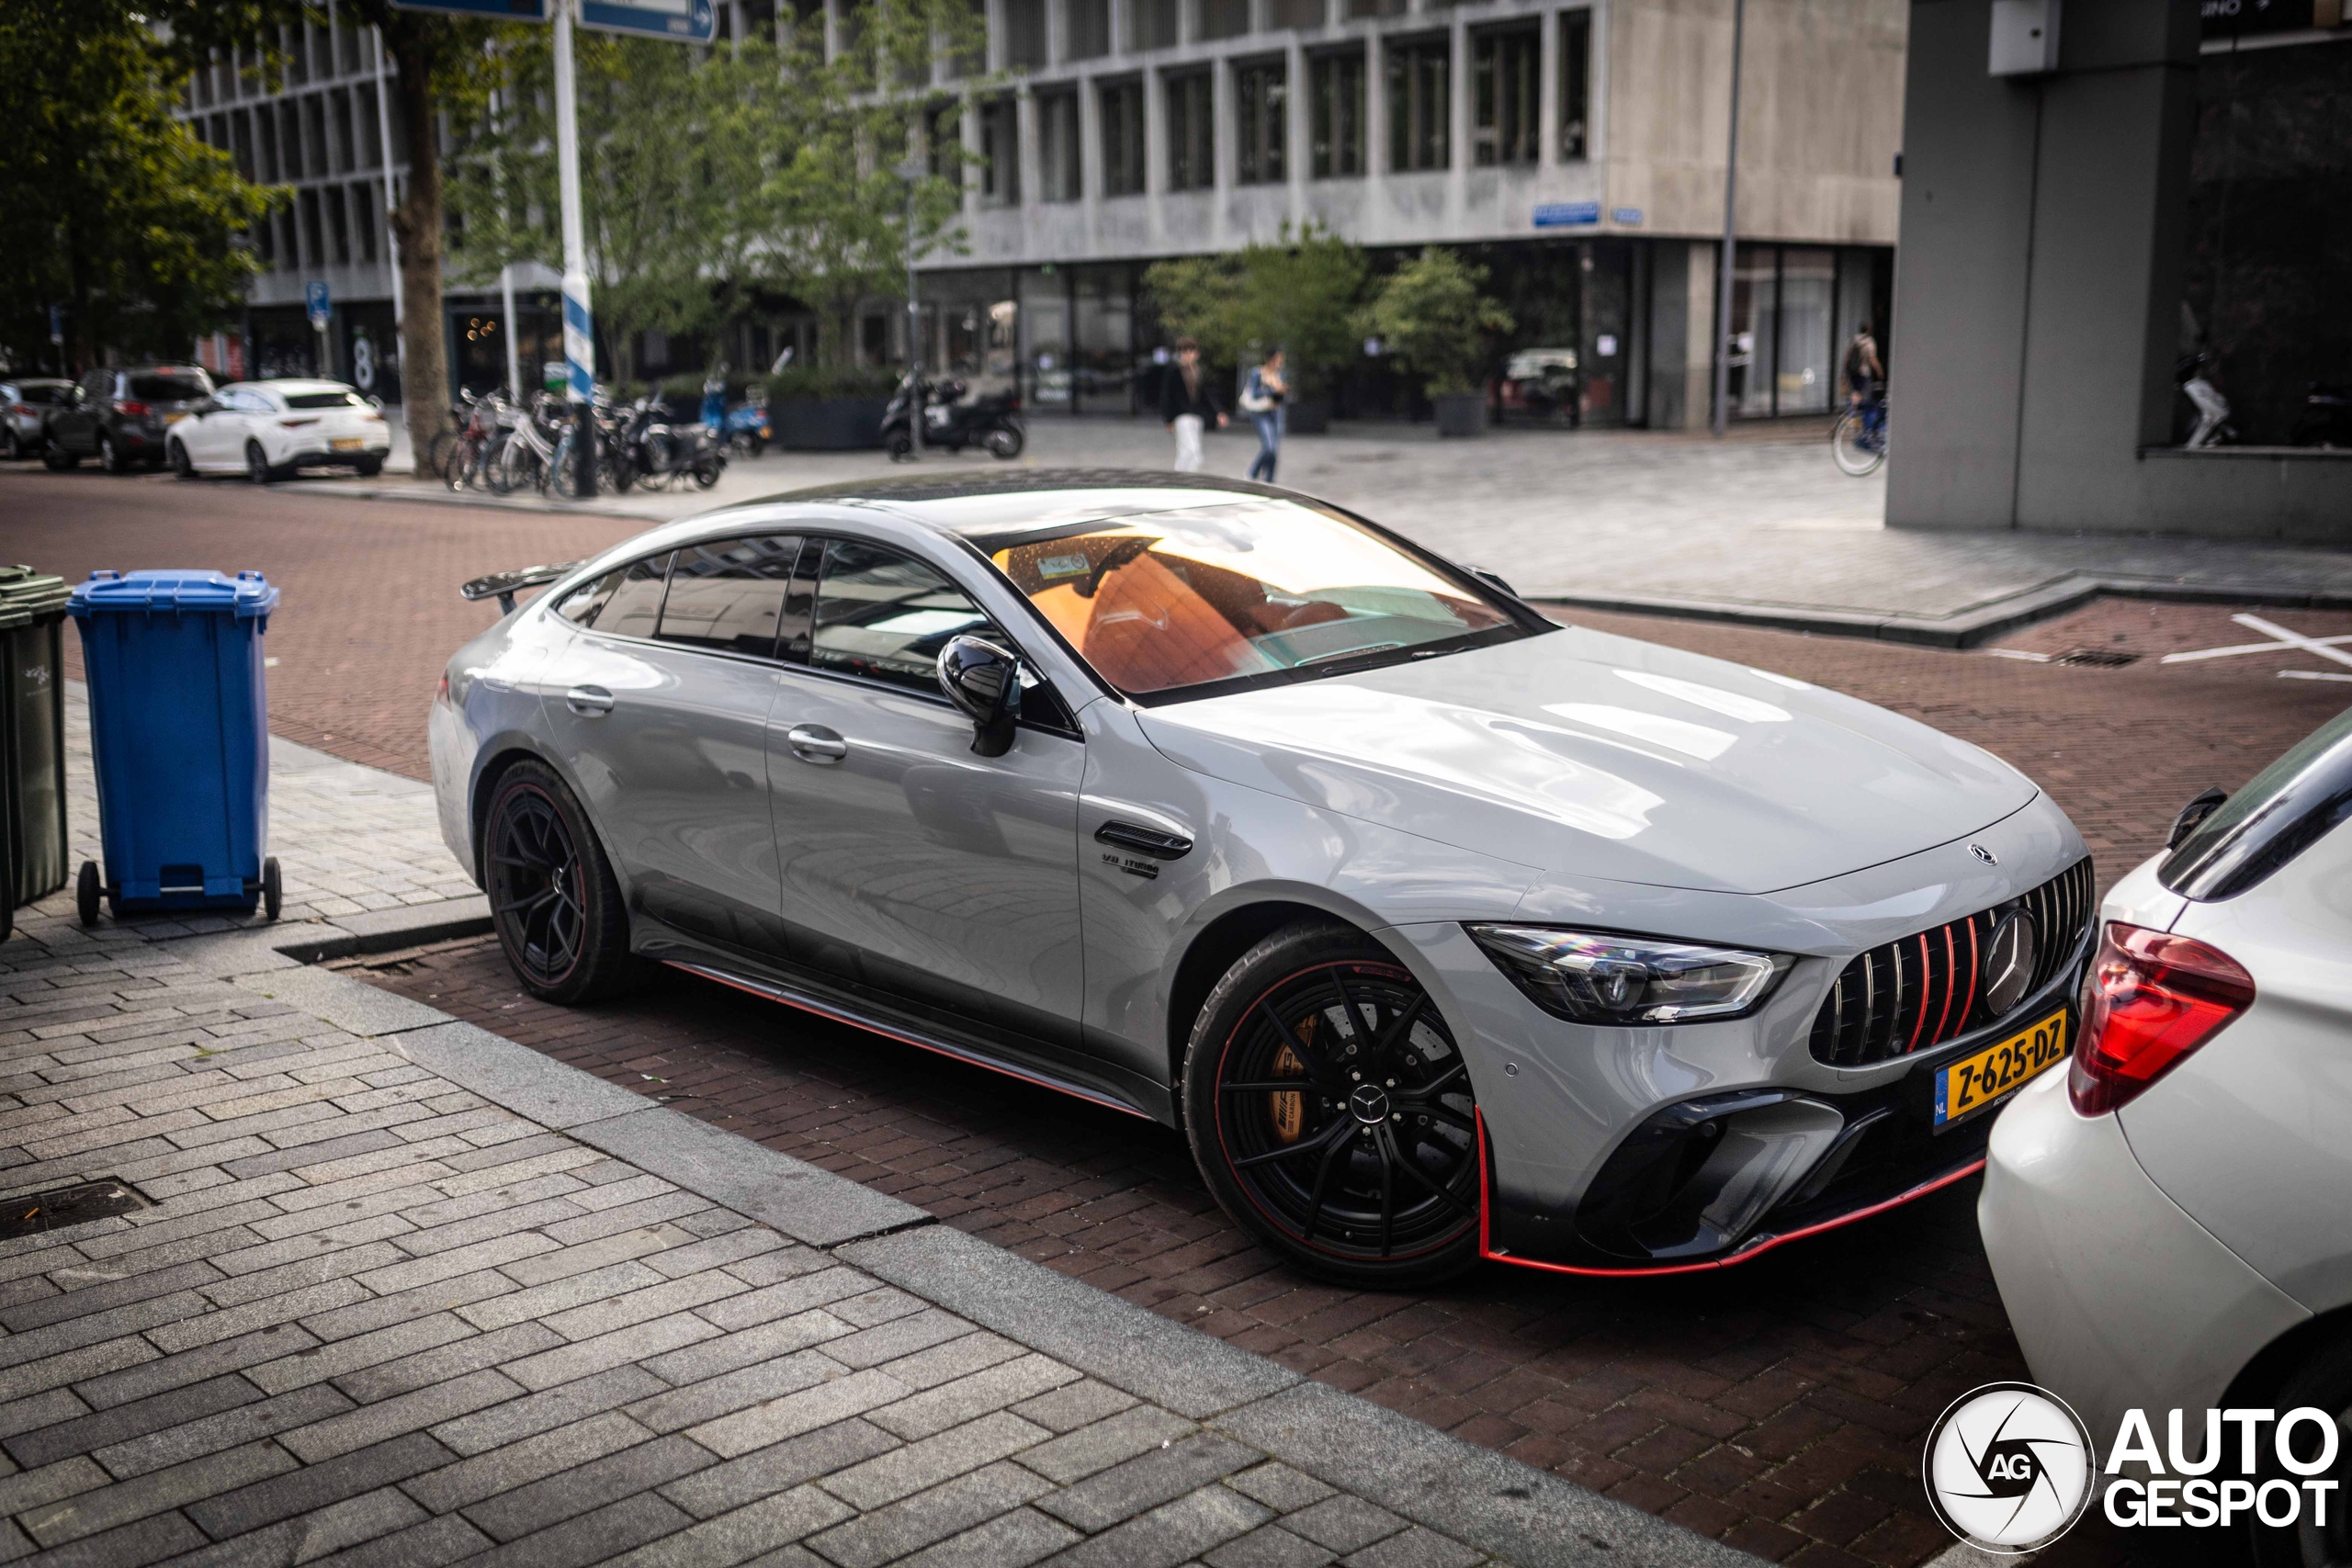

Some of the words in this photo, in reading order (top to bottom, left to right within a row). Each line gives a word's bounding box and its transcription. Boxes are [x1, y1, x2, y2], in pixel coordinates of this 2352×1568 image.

[1958, 1019, 2062, 1108] Z-625-DZ
[1288, 1093, 1296, 1120] CARBON
[1935, 1102, 1946, 1116] NL
